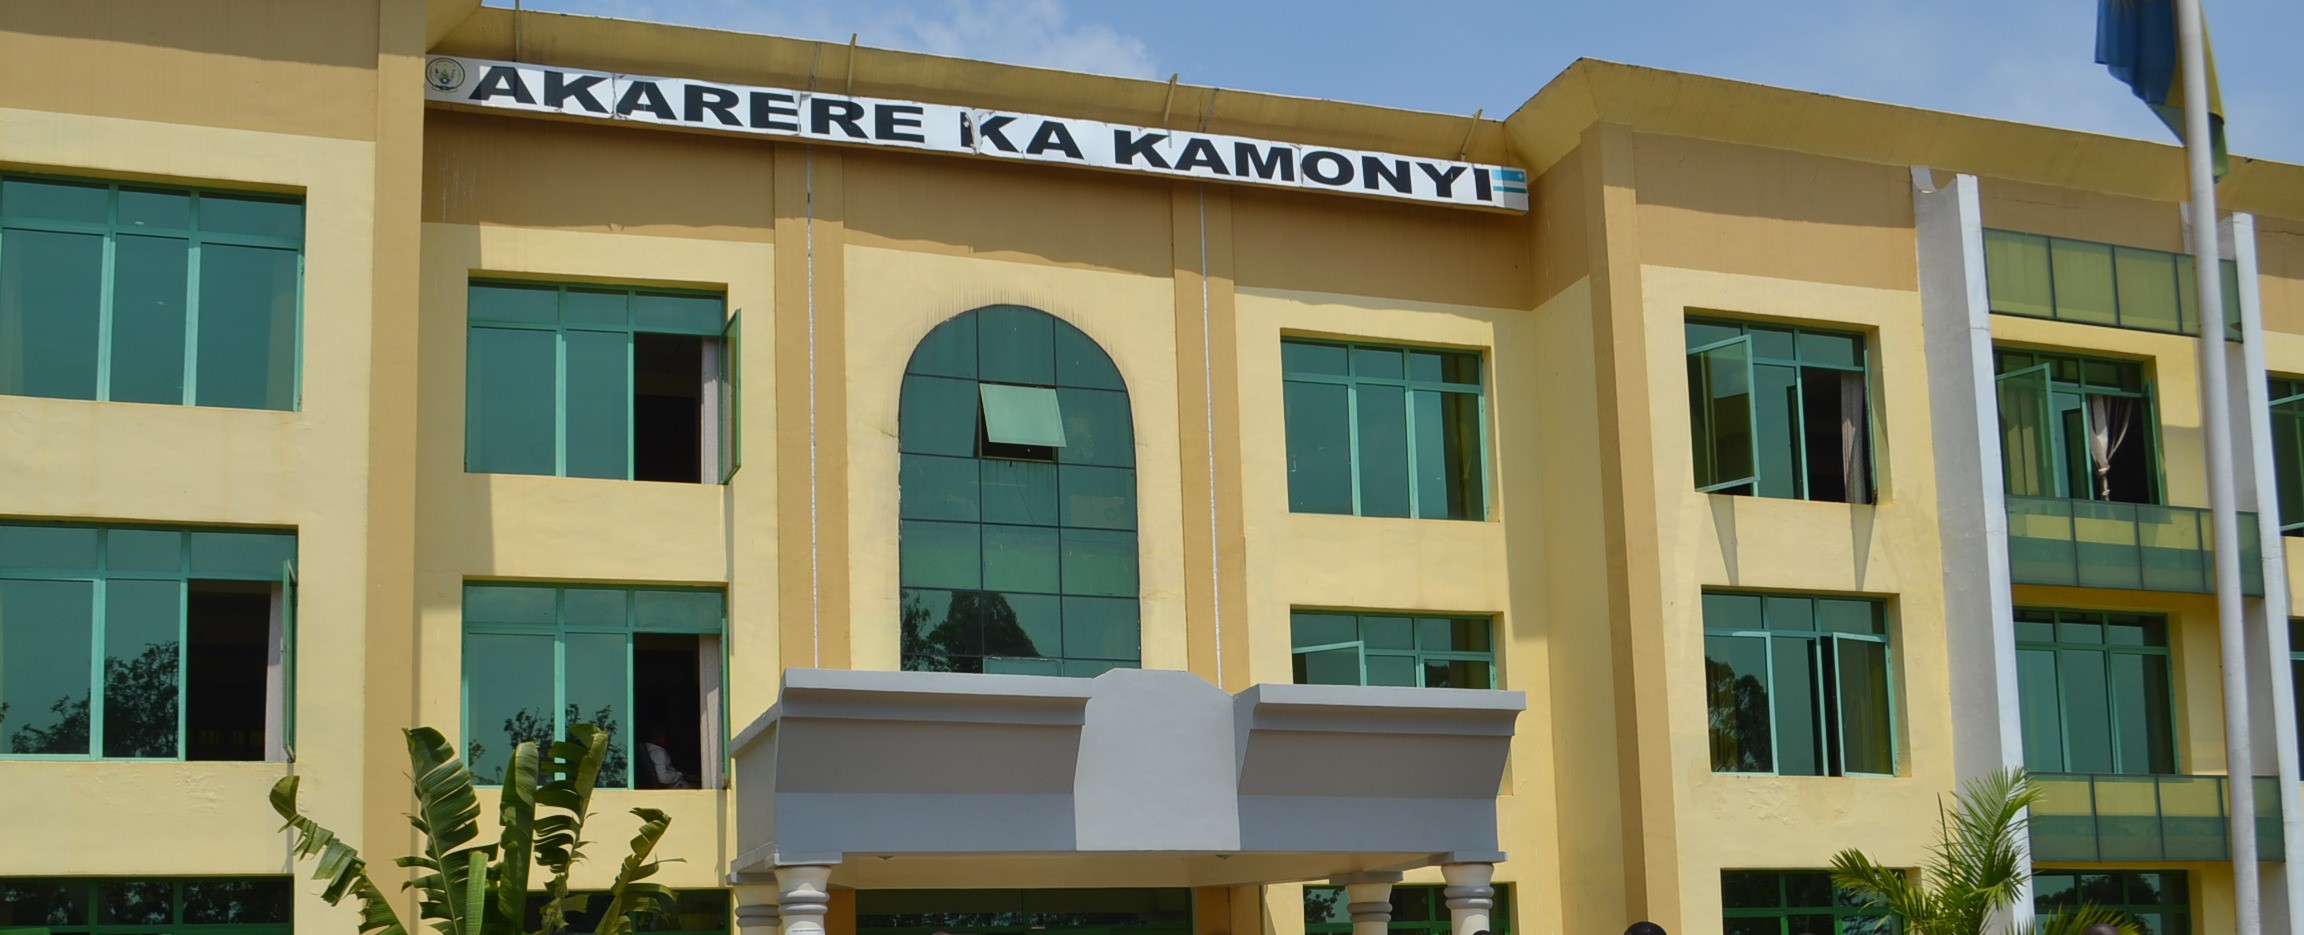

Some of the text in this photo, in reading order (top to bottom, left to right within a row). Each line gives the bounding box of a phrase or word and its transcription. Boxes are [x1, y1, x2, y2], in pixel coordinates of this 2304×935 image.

[468, 65, 1493, 202] AKARERE KA KAMONYI
